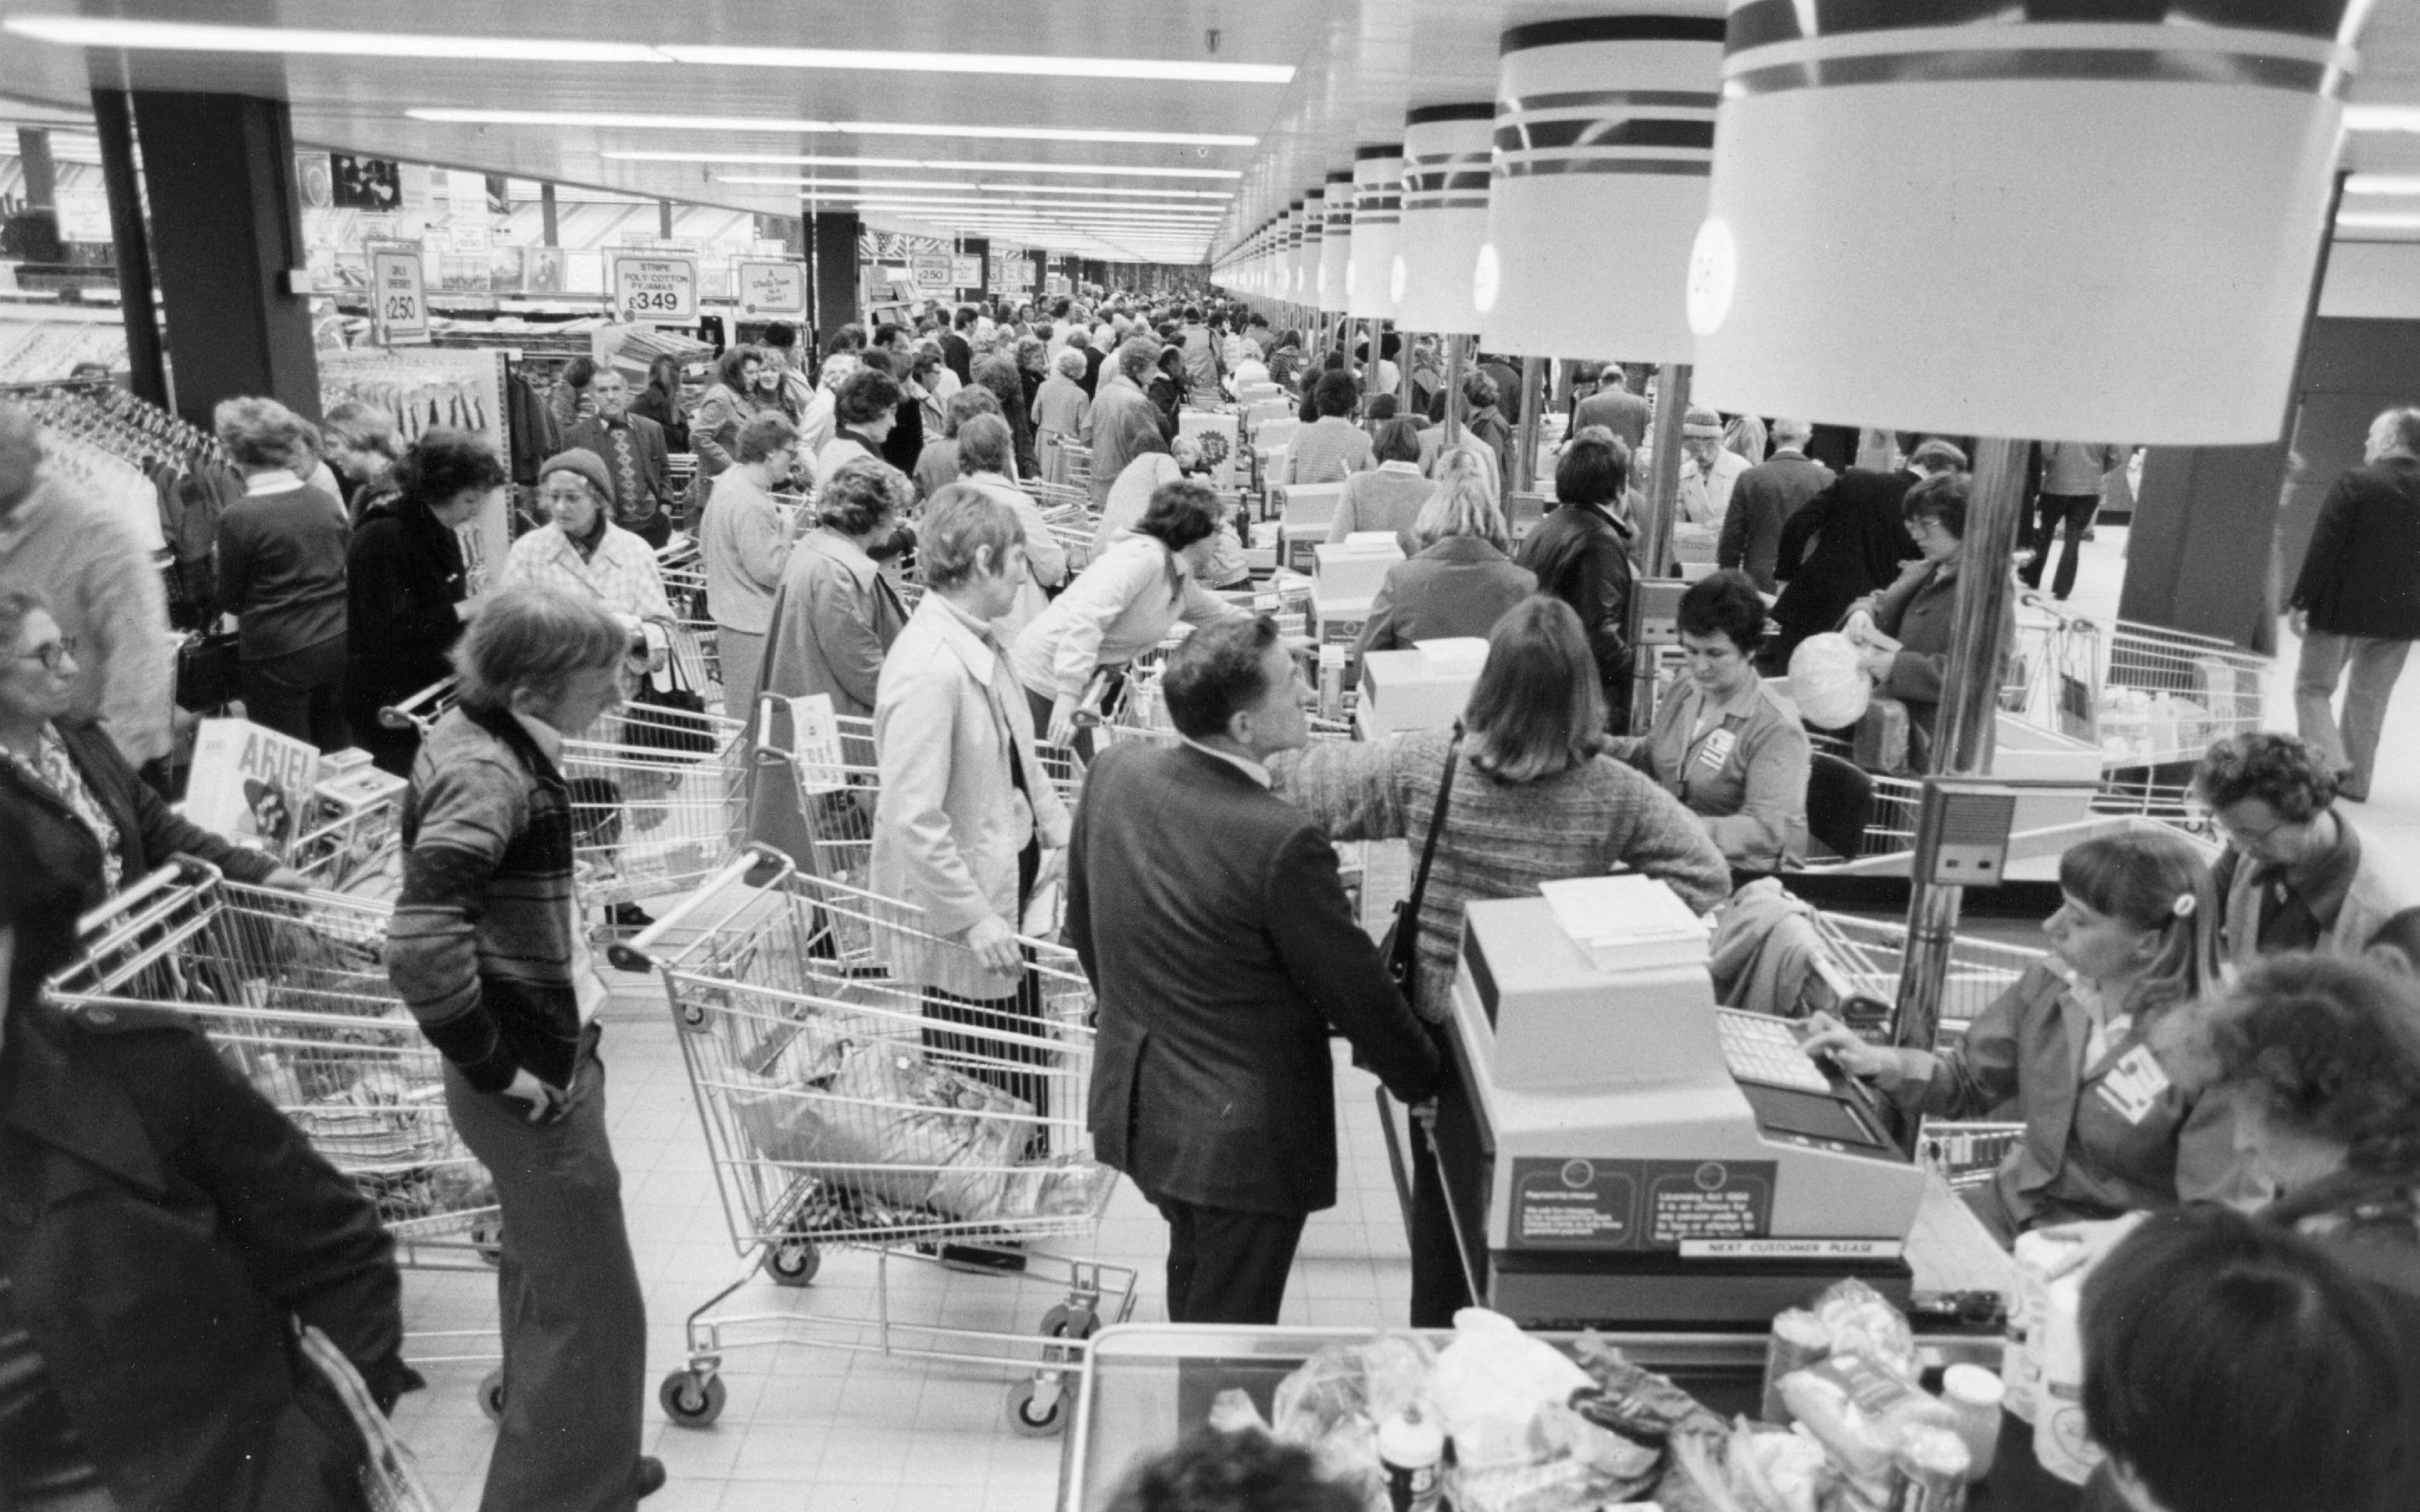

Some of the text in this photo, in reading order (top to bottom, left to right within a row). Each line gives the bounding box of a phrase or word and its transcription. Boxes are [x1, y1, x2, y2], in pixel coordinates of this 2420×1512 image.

[651, 274, 689, 283] COTTON
[631, 281, 674, 291] PYJAMAS
[385, 295, 416, 320] £250
[628, 292, 677, 310] £349
[237, 731, 310, 792] ARIEL
[1708, 1243, 1873, 1254] NEXT CUSTOMER PLEASE
